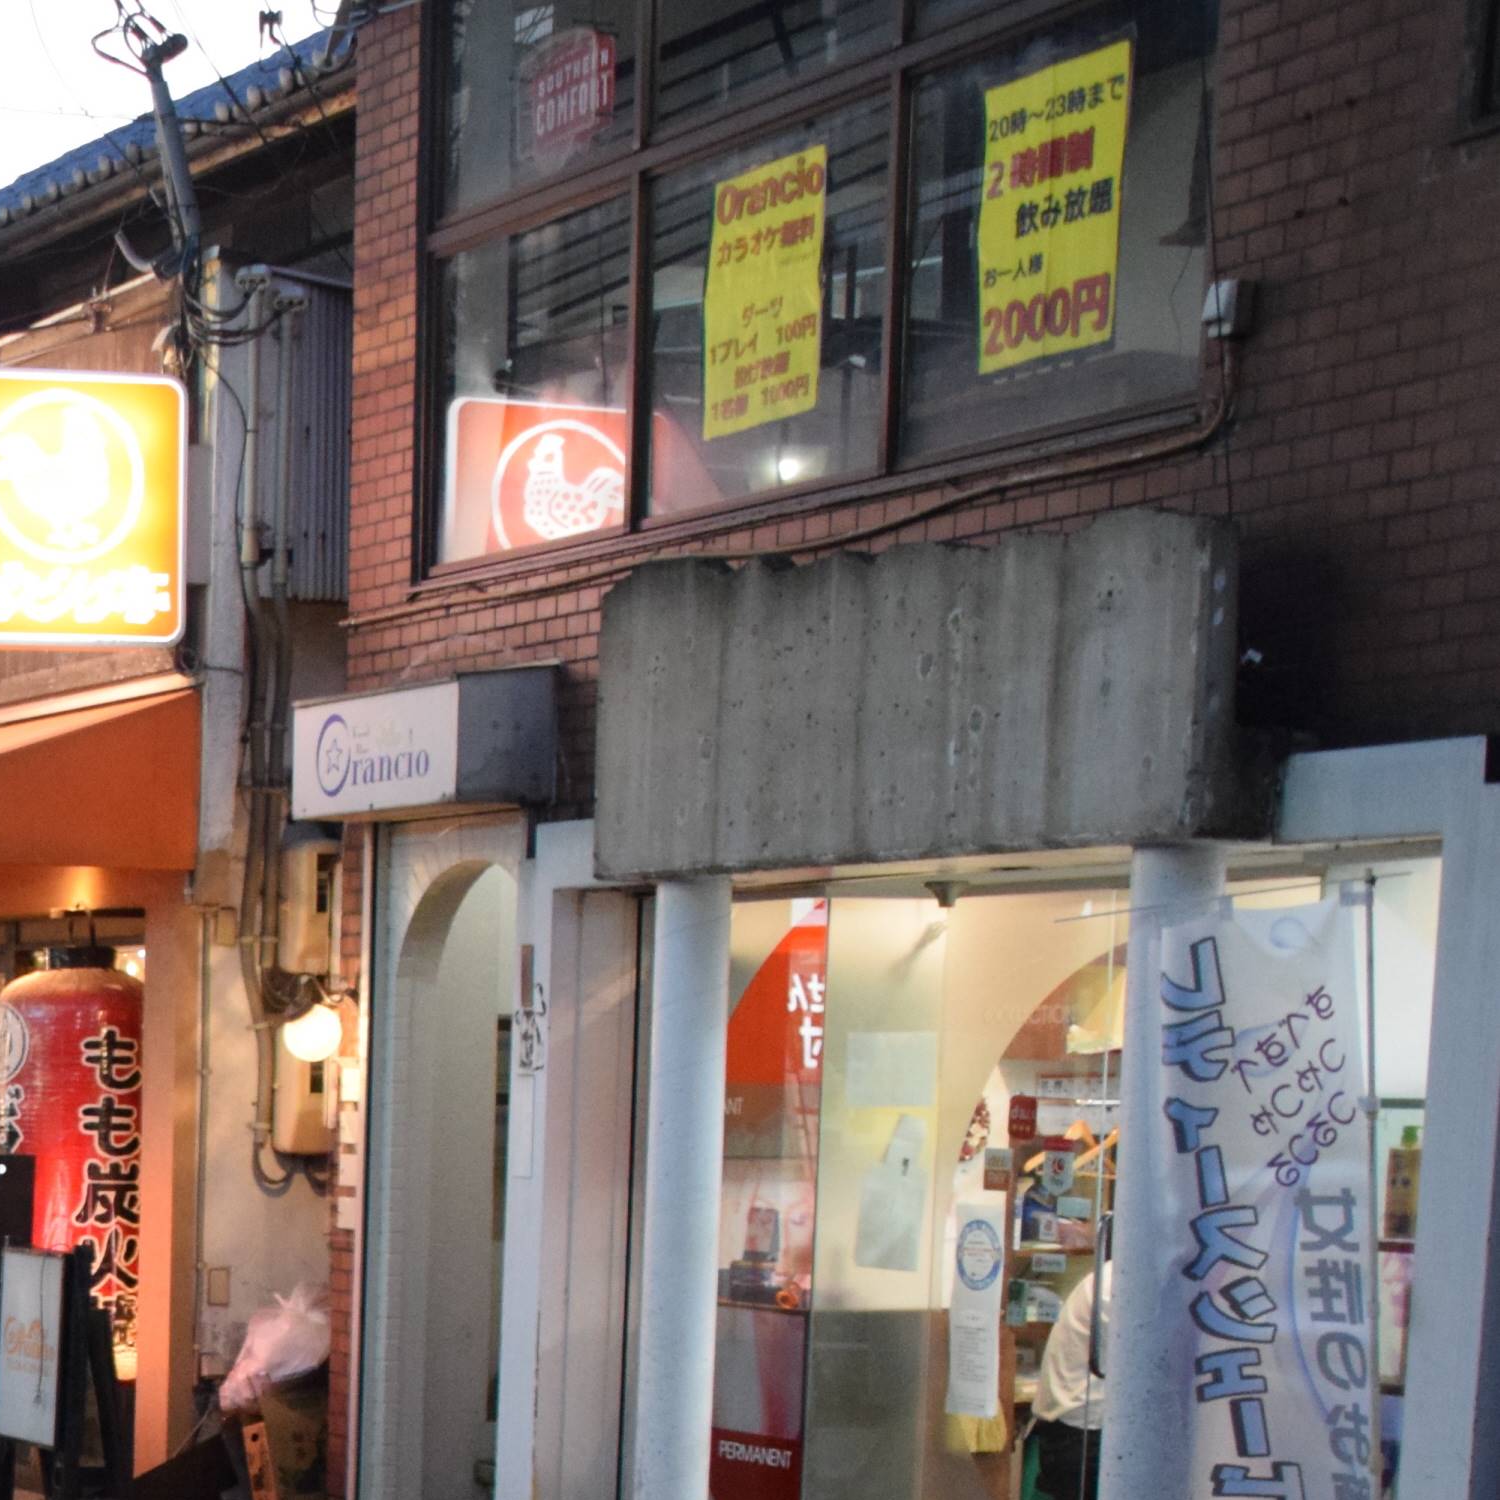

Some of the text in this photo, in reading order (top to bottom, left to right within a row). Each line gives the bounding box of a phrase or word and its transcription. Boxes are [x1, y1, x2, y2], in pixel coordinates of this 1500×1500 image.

[716, 156, 825, 226] Orancio
[1015, 176, 1115, 239] 飲み放題
[982, 272, 1112, 356] 2000円
[315, 713, 430, 798] Orancio
[718, 1439, 793, 1471] PERMANENT
